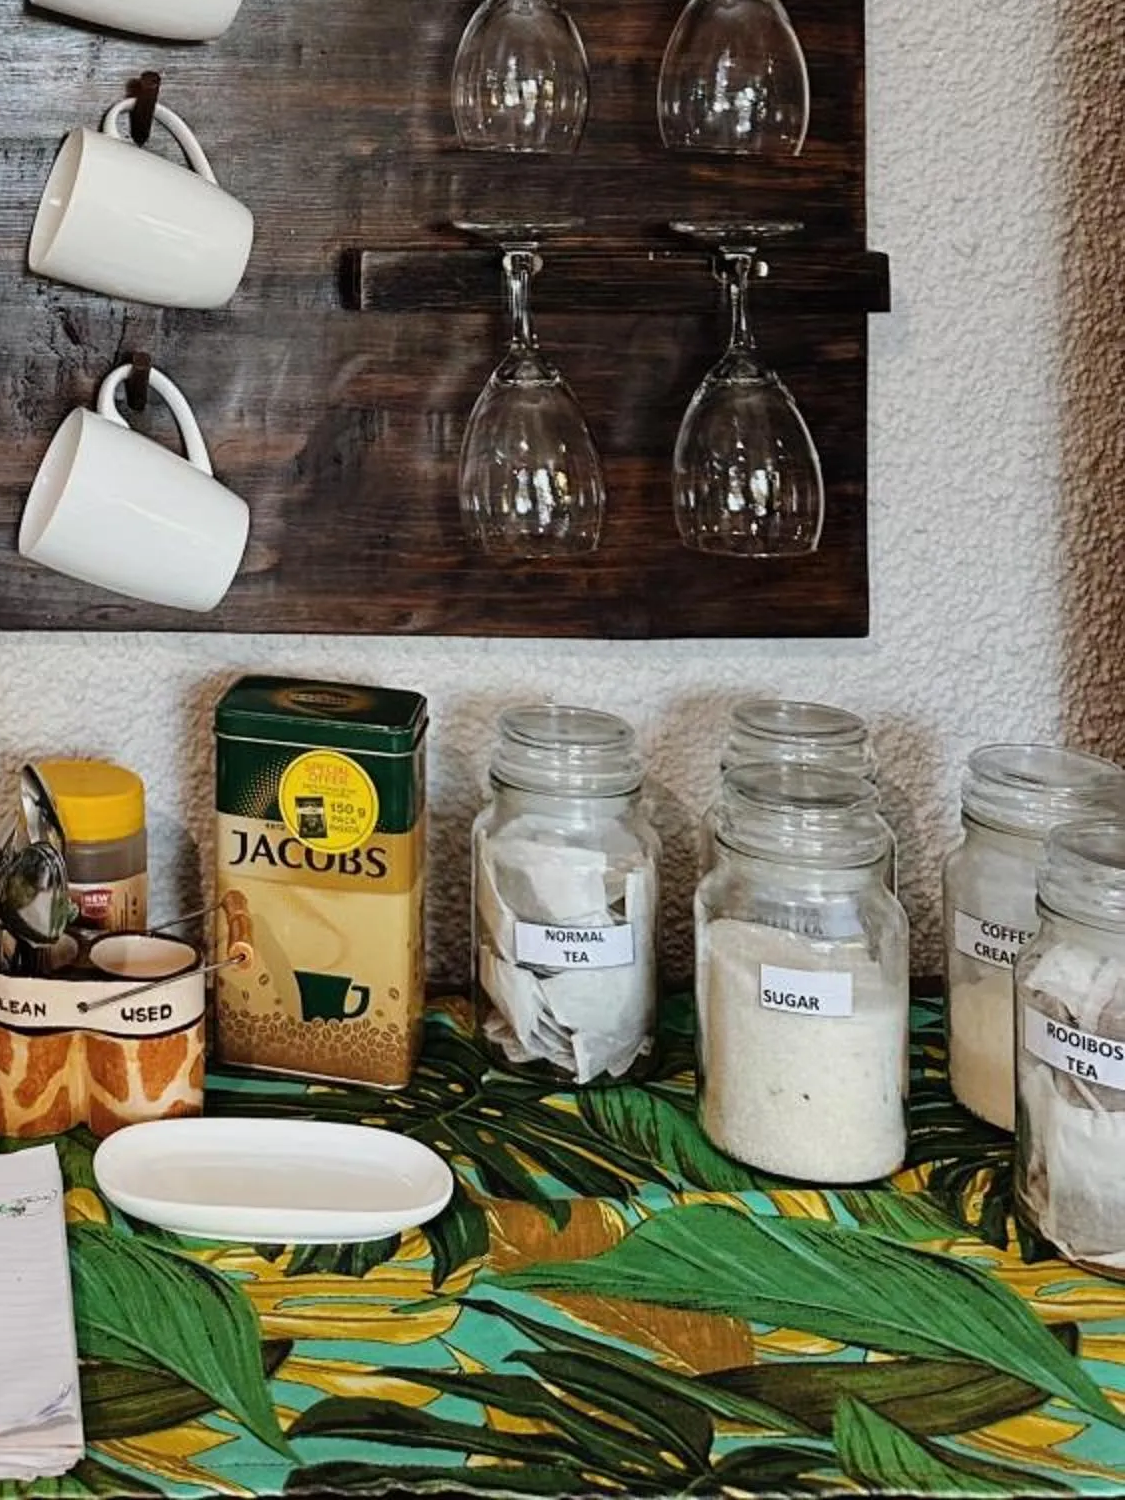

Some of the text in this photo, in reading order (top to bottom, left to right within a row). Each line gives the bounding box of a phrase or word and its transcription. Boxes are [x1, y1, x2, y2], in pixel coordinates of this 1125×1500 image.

[228, 829, 388, 879] JACOBS
[544, 929, 605, 943] NORMAL
[563, 951, 590, 963] TEA
[762, 989, 820, 1011] SUGAR
[120, 1004, 172, 1023] USED
[1046, 1021, 1125, 1062] ROOIBOS
[1066, 1055, 1099, 1080] TEA
